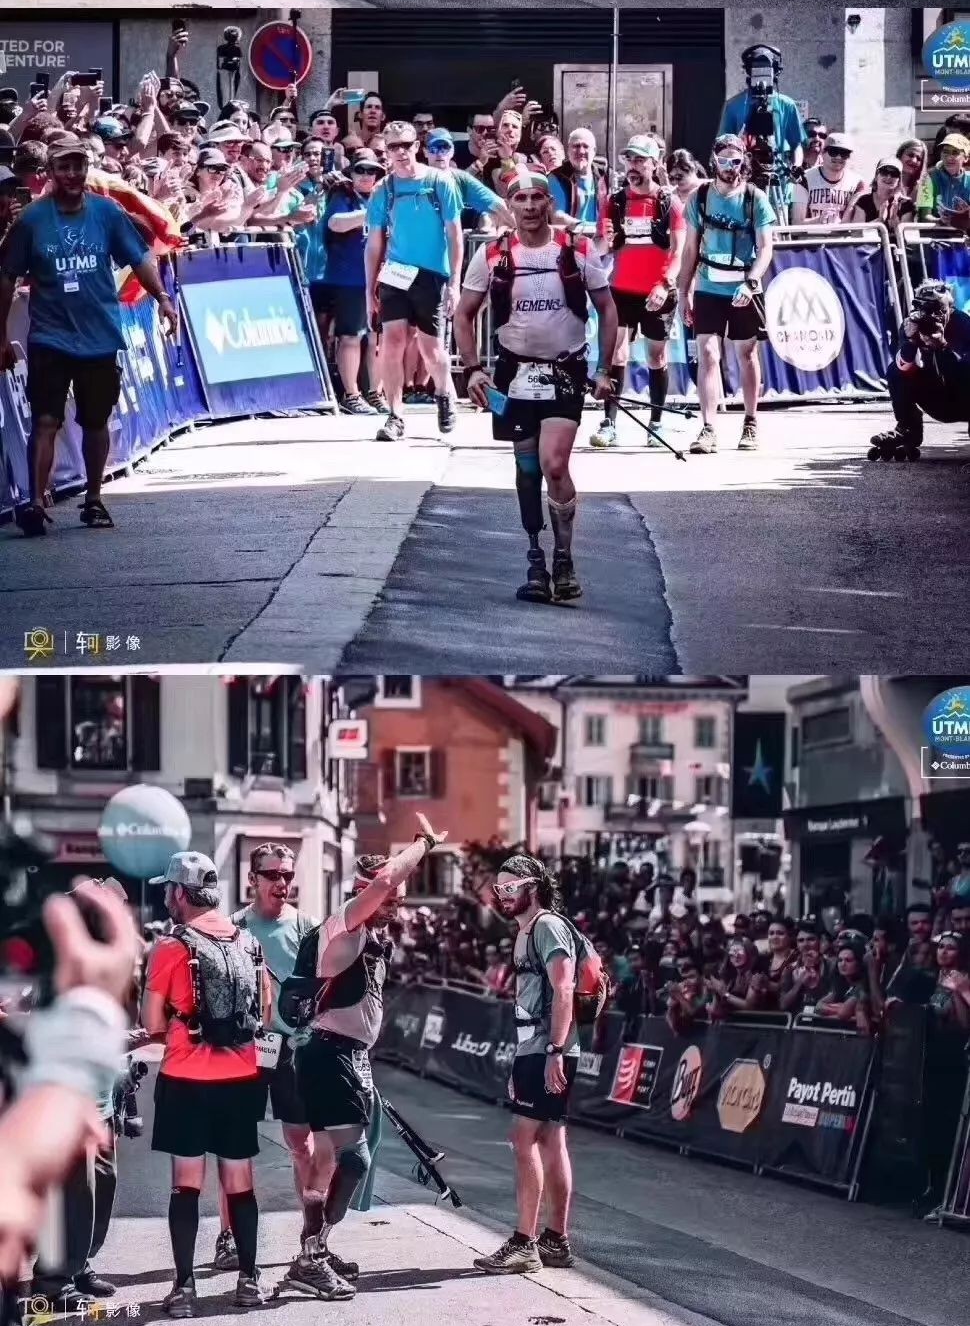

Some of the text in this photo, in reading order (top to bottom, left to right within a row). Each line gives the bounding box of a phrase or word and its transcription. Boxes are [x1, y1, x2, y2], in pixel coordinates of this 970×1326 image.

[34, 40, 65, 52] FOR
[6, 55, 66, 67] ENTURE
[56, 255, 98, 271] UTMB
[787, 1077, 821, 1104] Payot
[820, 1082, 856, 1108] Pertin
